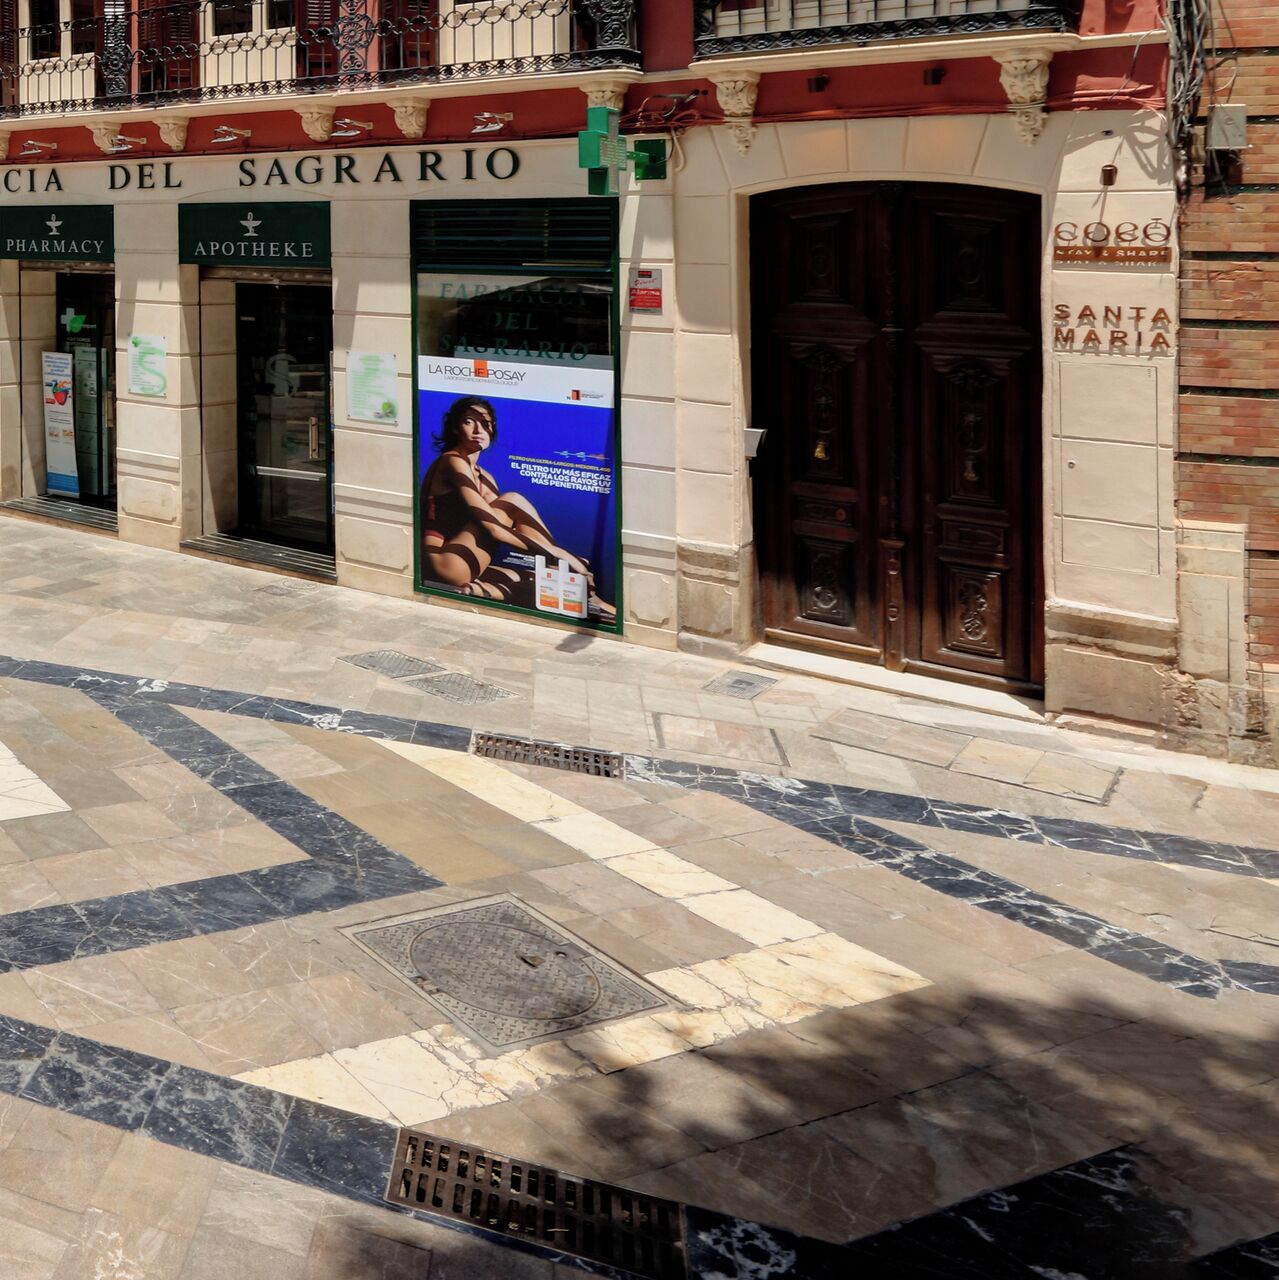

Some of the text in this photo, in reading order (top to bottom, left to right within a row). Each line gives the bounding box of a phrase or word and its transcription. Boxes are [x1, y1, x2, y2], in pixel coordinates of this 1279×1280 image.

[108, 162, 183, 190] DEL
[238, 147, 520, 187] SAGRARIO
[6, 239, 104, 255] PHARMACY
[194, 241, 313, 258] APOTHEKE
[1055, 304, 1172, 323] SANTA
[1055, 327, 1170, 348] MARIA
[428, 363, 526, 381] LA ROCHE POSAY
[520, 469, 553, 480] CONTRA
[570, 477, 598, 486] RAYOS
[521, 463, 549, 473] FILTRO
[562, 469, 580, 477] MÁS
[581, 472, 611, 481] EFICAZ
[549, 481, 611, 494] PENETRANTES
